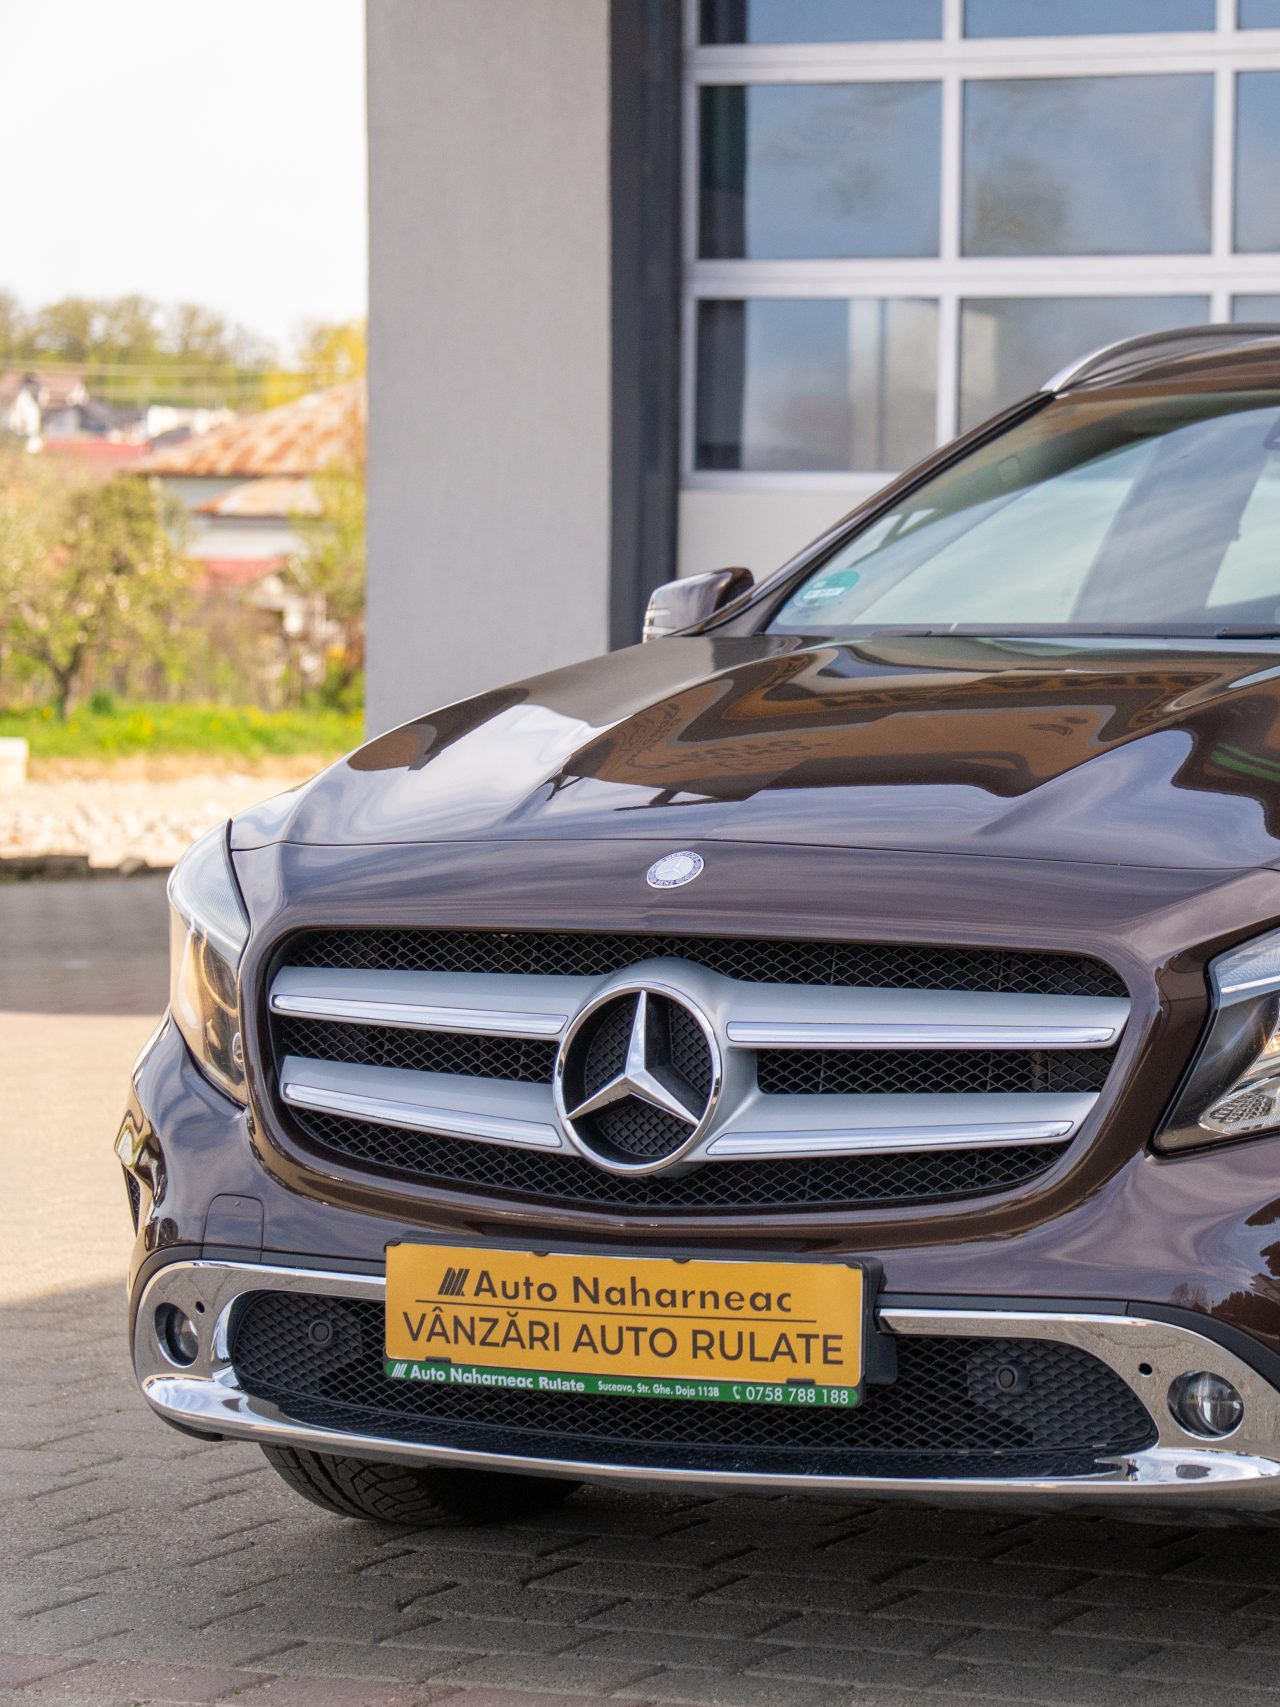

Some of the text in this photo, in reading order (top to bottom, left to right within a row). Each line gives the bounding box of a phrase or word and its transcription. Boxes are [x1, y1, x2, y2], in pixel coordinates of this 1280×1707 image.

[473, 1269, 792, 1313] Auto Naharneac
[402, 1307, 845, 1366] VÂNZĂRI AUTO RULATE
[410, 1365, 849, 1404] Auto Naharneac Rulate Suceava, Str. Ghe. Doja 113B 0758 788 188
